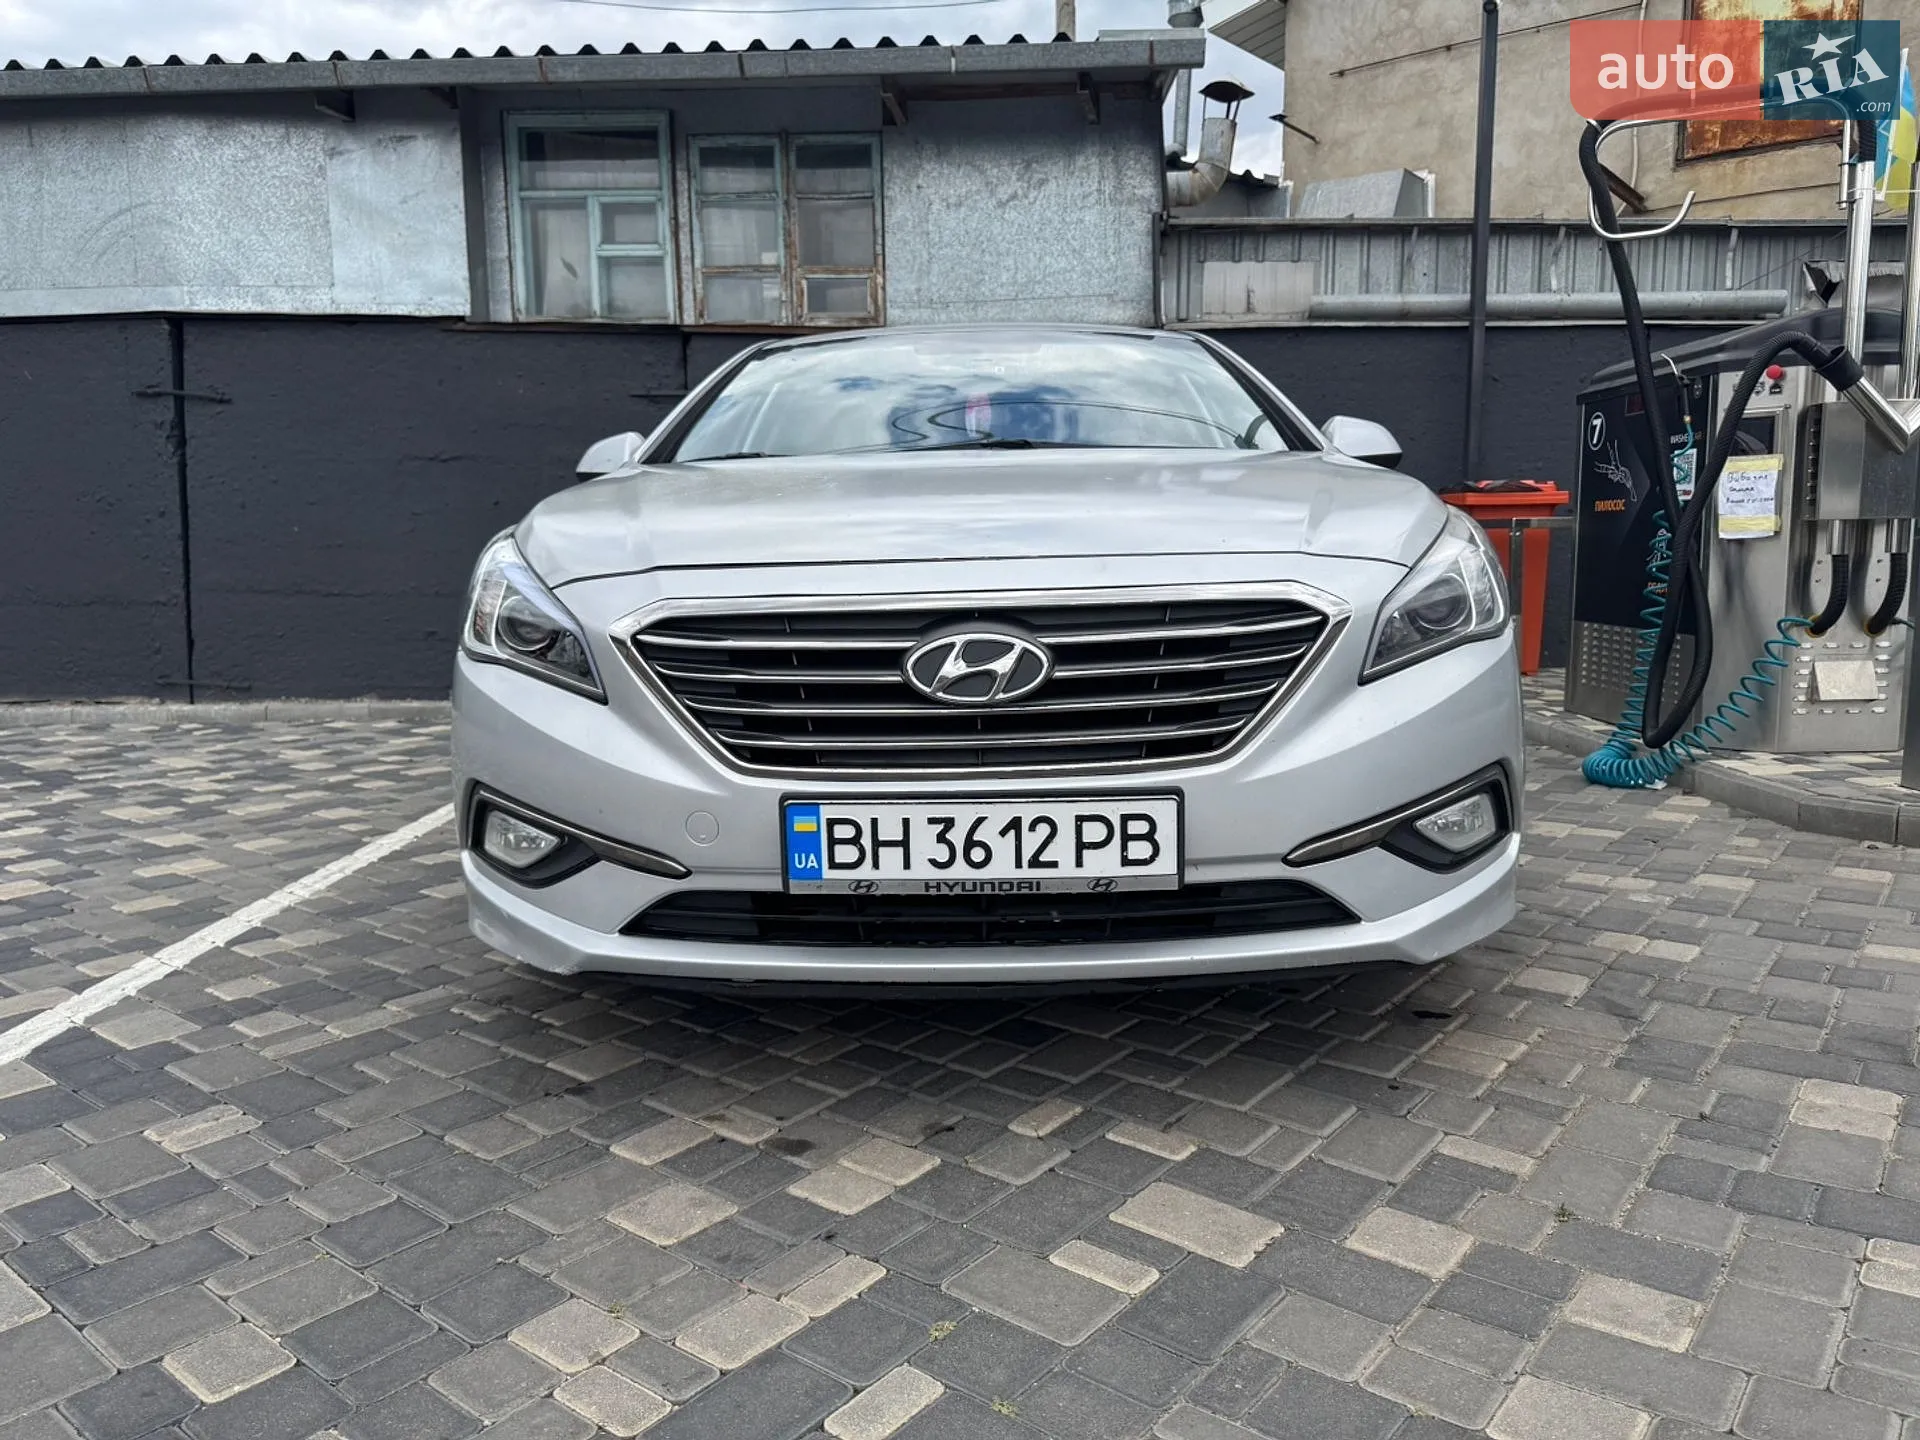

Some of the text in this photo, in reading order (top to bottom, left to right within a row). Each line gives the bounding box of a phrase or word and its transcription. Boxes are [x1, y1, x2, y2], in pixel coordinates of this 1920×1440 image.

[1592, 418, 1603, 444] 7
[826, 813, 1160, 871] BH 3612 PB
[794, 853, 819, 869] UA
[924, 881, 1042, 894] HYUNDAI
